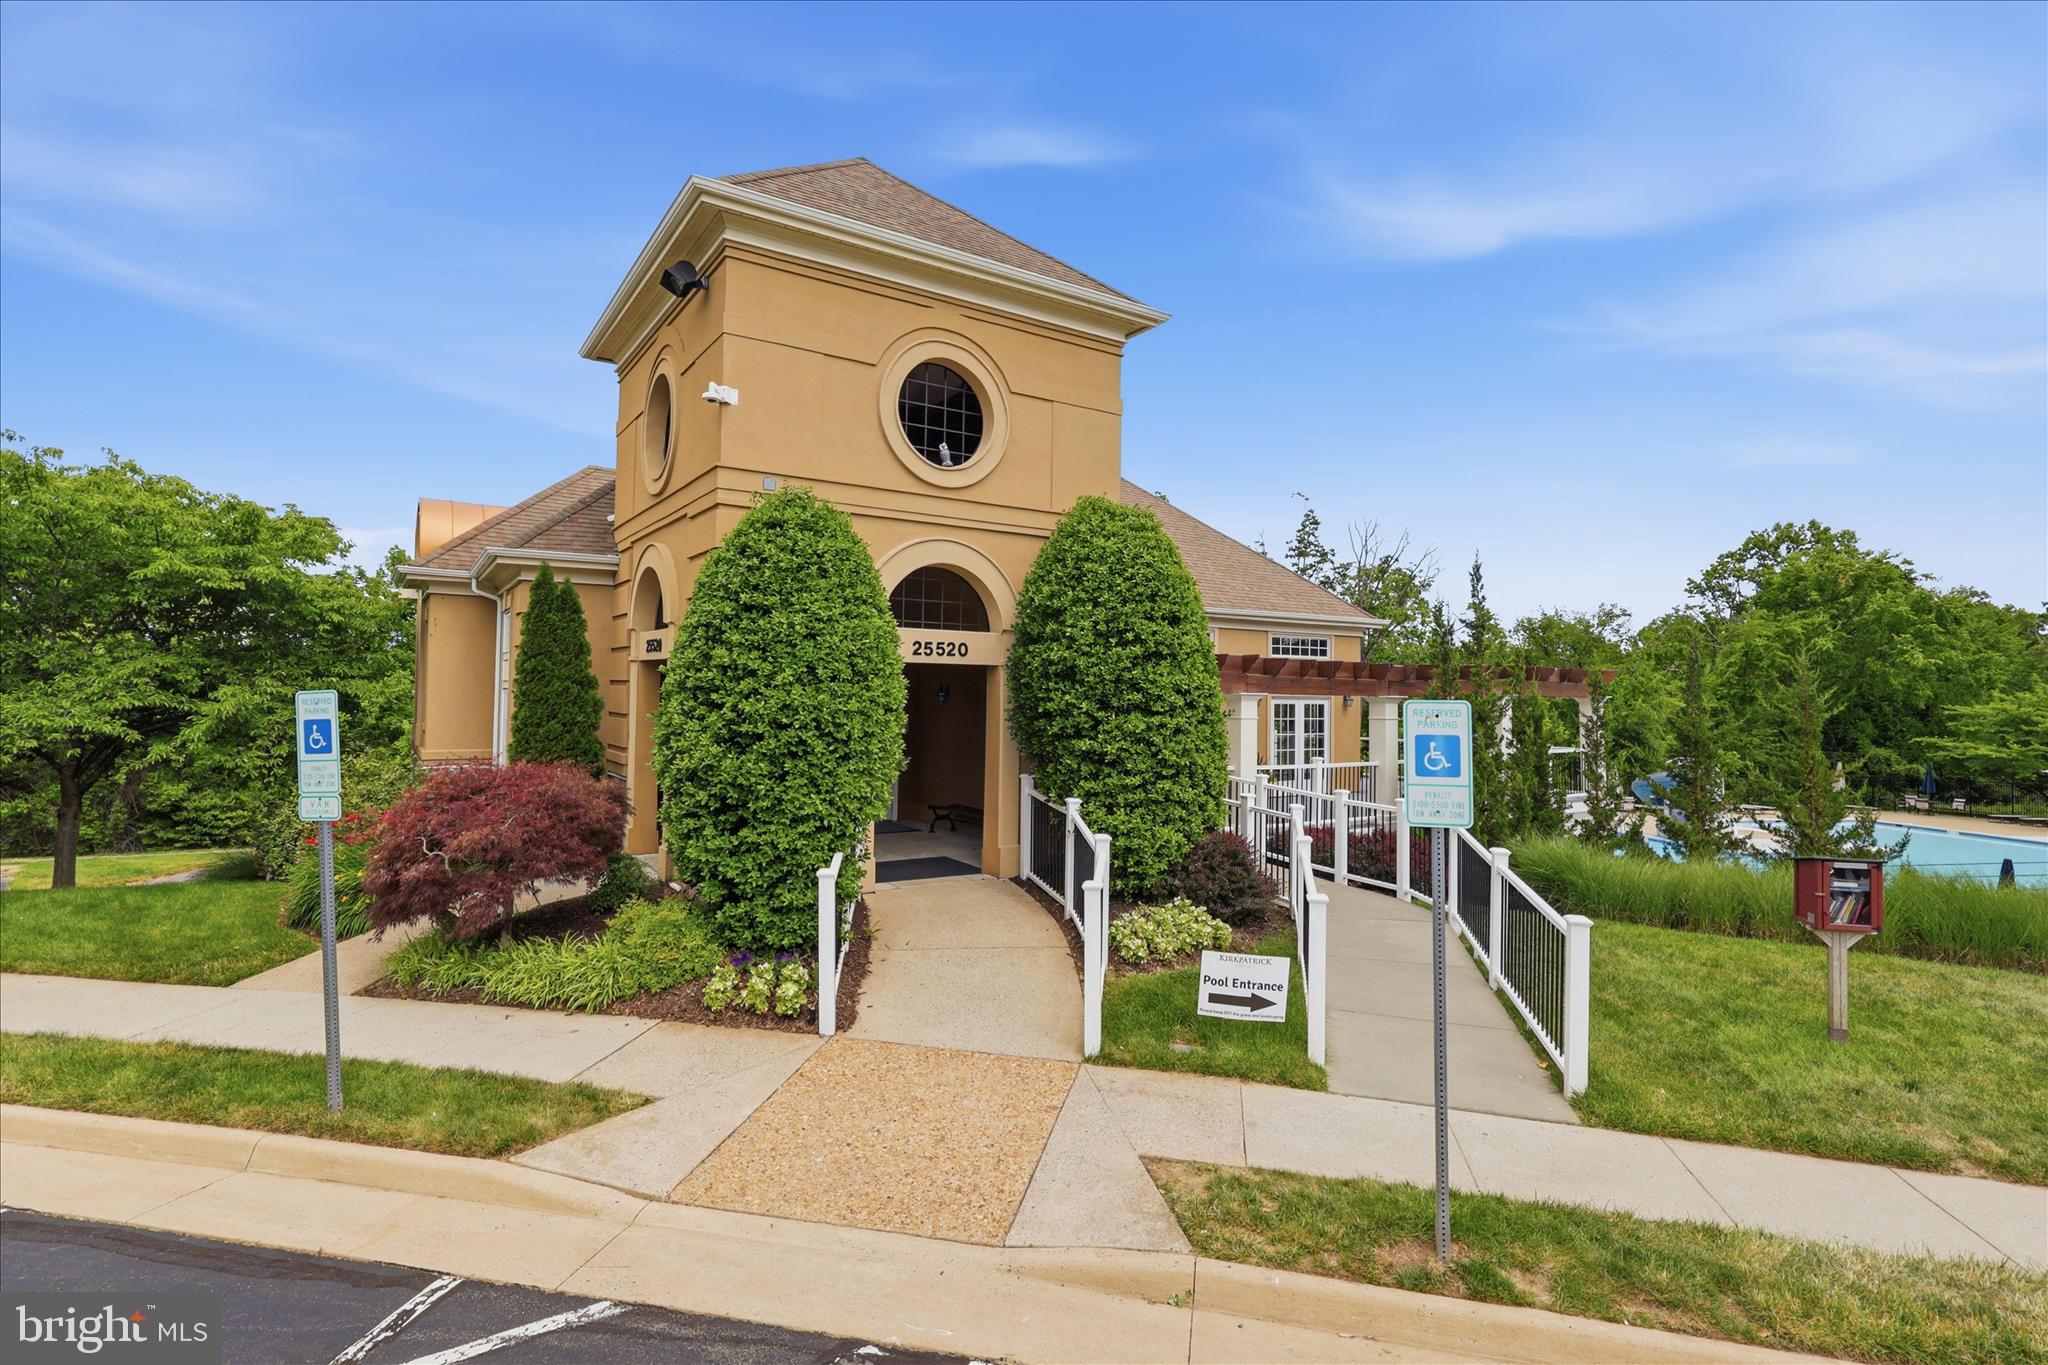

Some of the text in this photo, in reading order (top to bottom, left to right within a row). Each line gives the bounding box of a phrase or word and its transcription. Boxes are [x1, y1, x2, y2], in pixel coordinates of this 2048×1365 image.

[912, 641, 969, 658] 25520
[302, 697, 332, 705] RESERVED
[1412, 708, 1462, 718] RESERVED
[1417, 720, 1458, 730] PARKING
[1424, 791, 1452, 800] PENALTY
[1452, 802, 1466, 810] FINE
[1412, 810, 1466, 820] TOW AWAY ZONE
[1219, 954, 1272, 966] KIRKPATRICK
[1203, 974, 1284, 992] Pool Entrance
